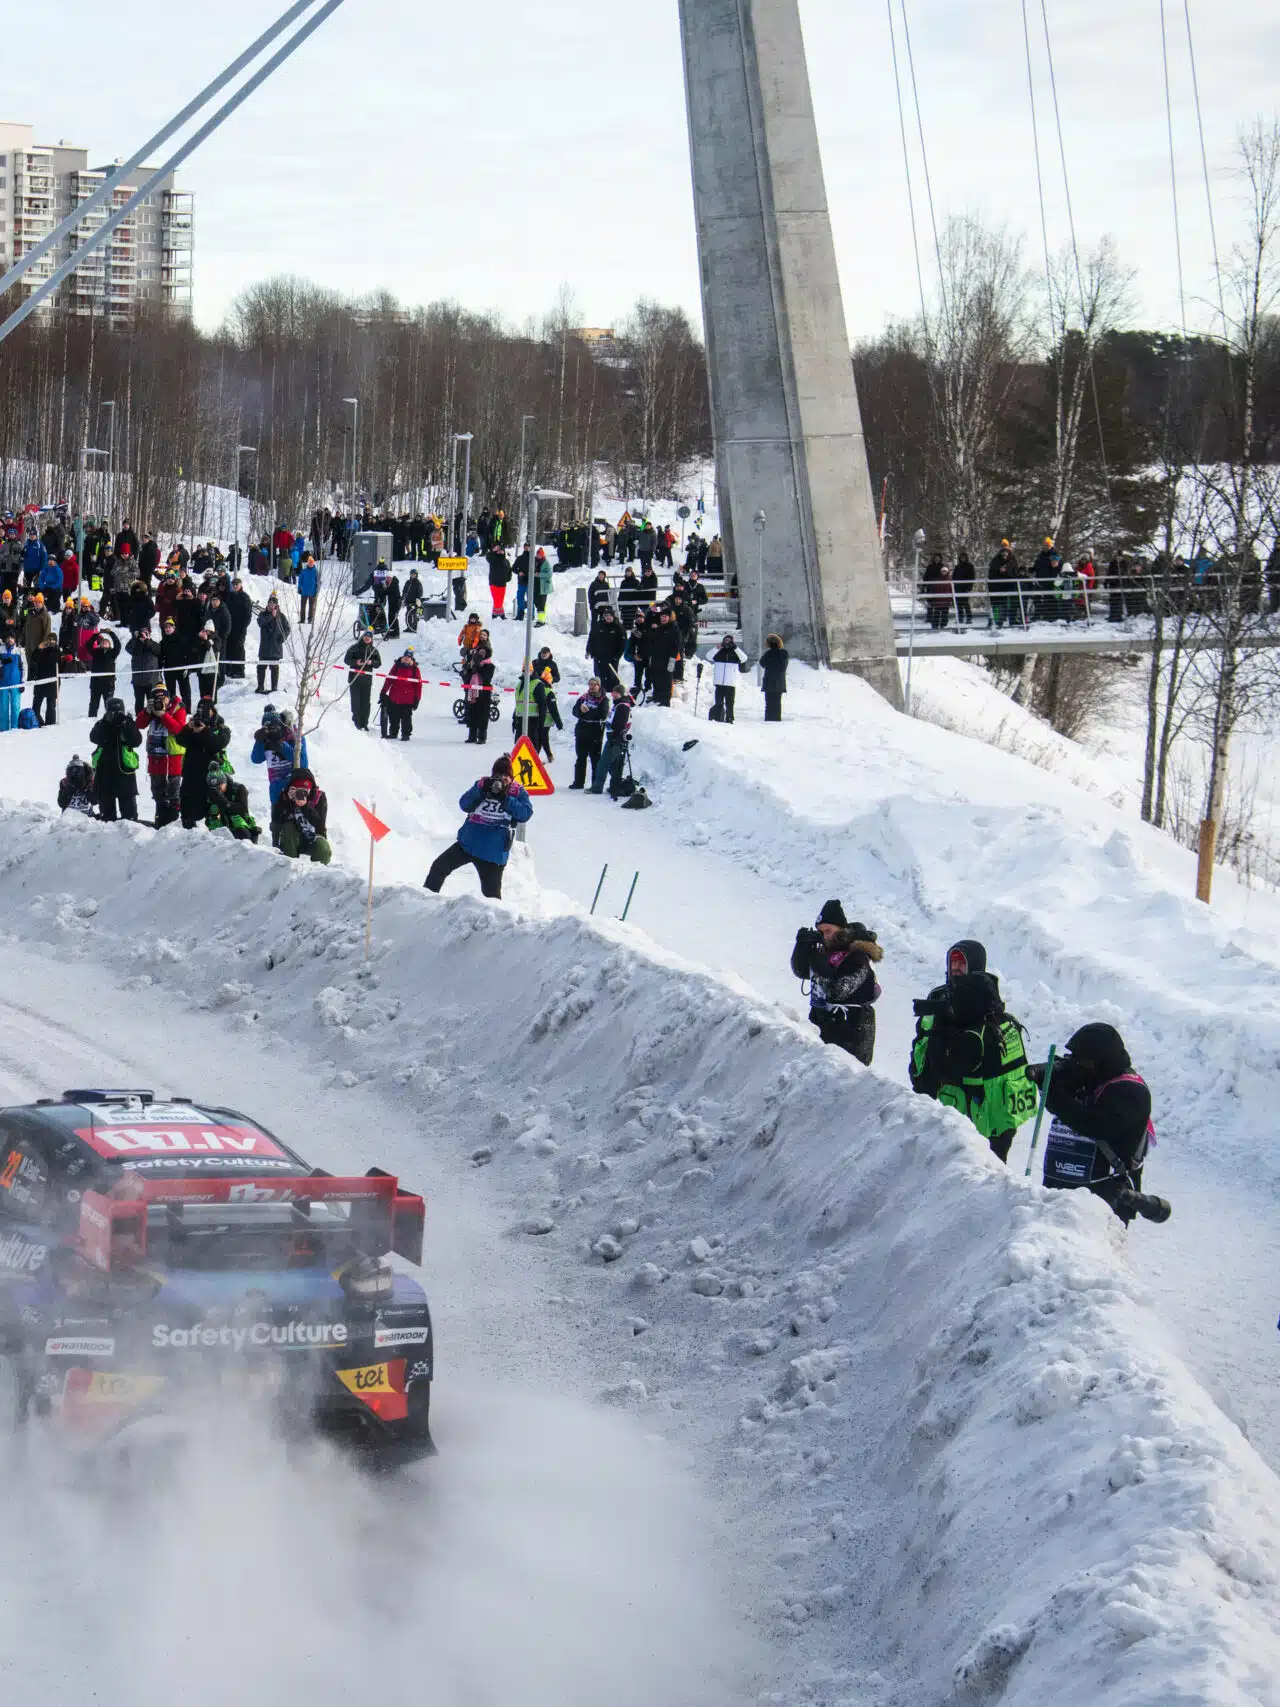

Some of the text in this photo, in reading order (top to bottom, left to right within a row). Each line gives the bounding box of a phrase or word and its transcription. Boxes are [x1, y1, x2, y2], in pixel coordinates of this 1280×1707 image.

[1008, 1089, 1037, 1115] 165
[122, 1157, 294, 1171] SafetyCulture
[151, 1320, 348, 1350] SafetyCulture
[354, 1367, 384, 1389] tet
